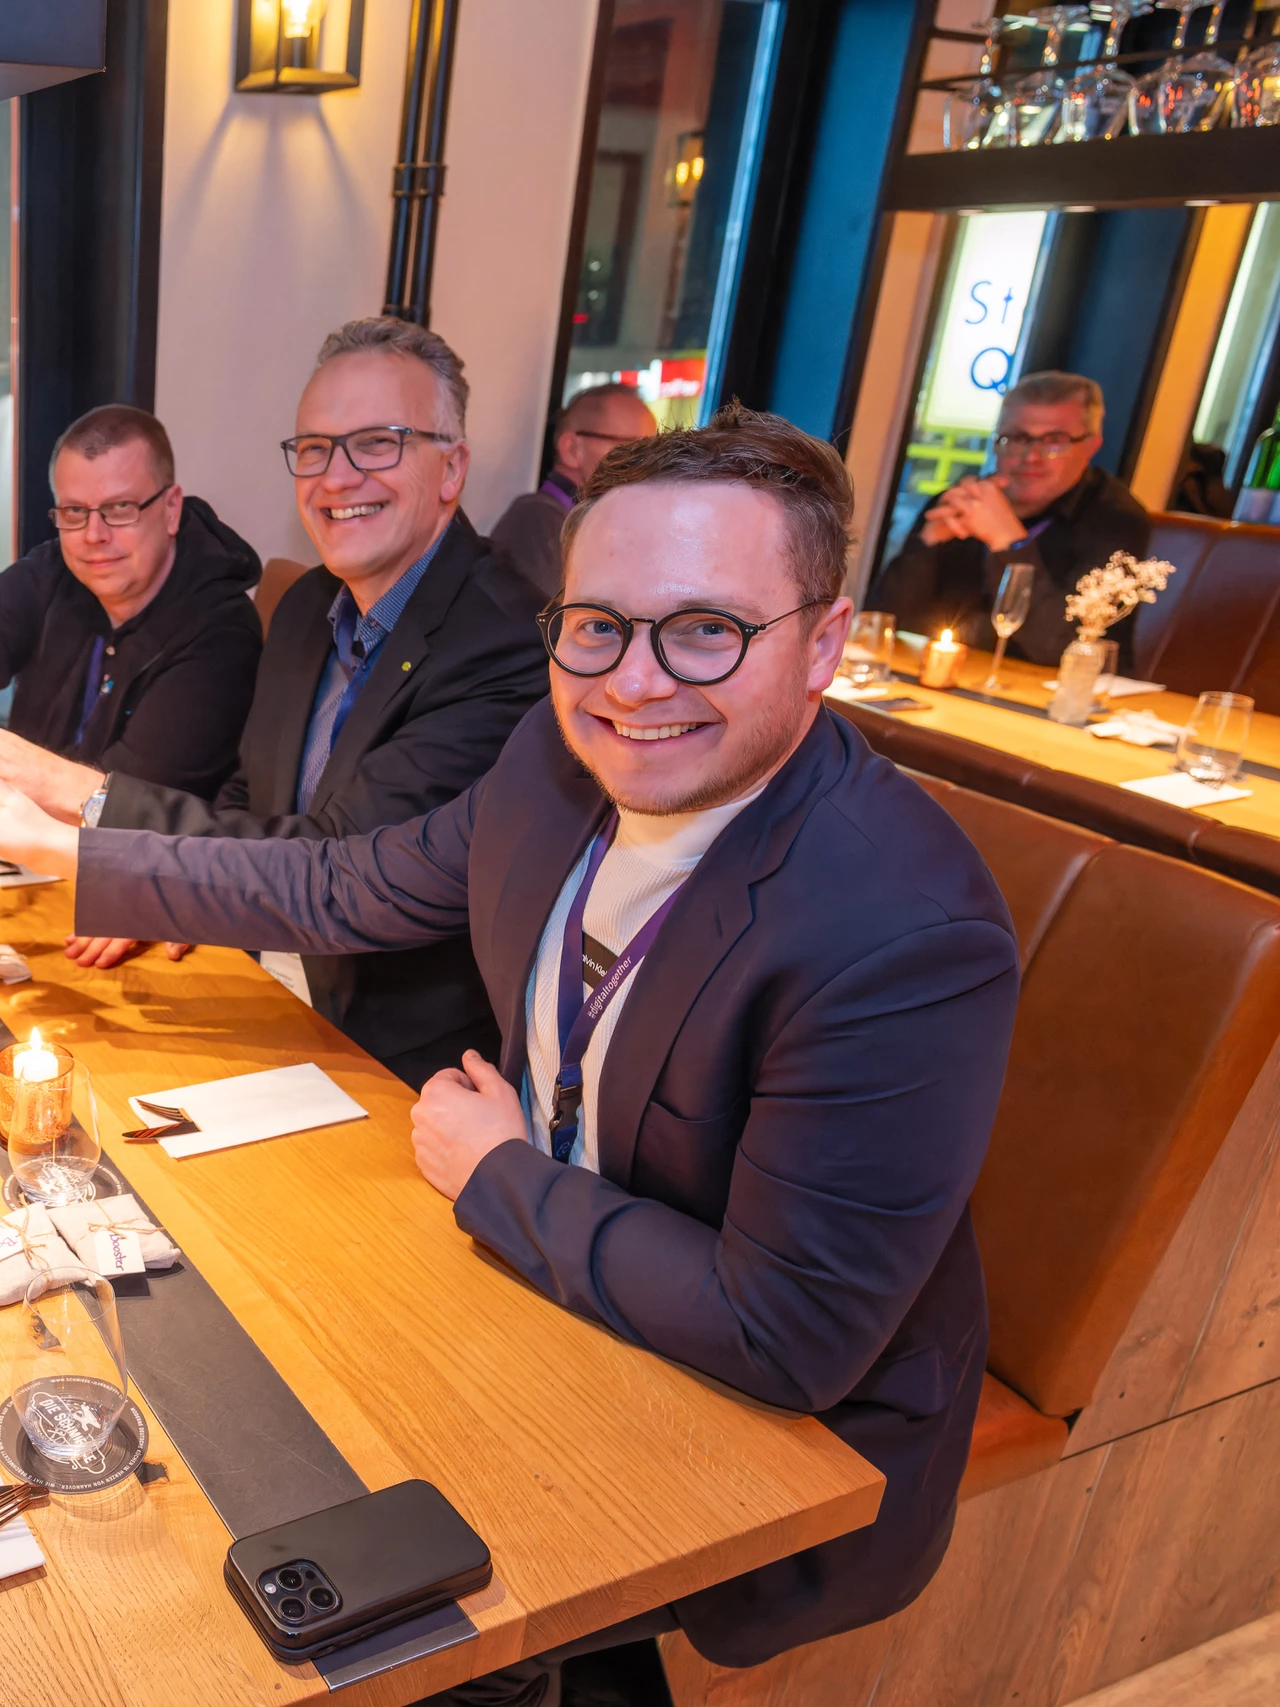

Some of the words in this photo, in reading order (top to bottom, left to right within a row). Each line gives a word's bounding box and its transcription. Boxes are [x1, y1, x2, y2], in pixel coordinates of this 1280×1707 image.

[582, 954, 596, 970] lvin
[587, 956, 632, 1020] #digitaltogether
[109, 1233, 124, 1271] Booster
[39, 1398, 61, 1416] DIE
